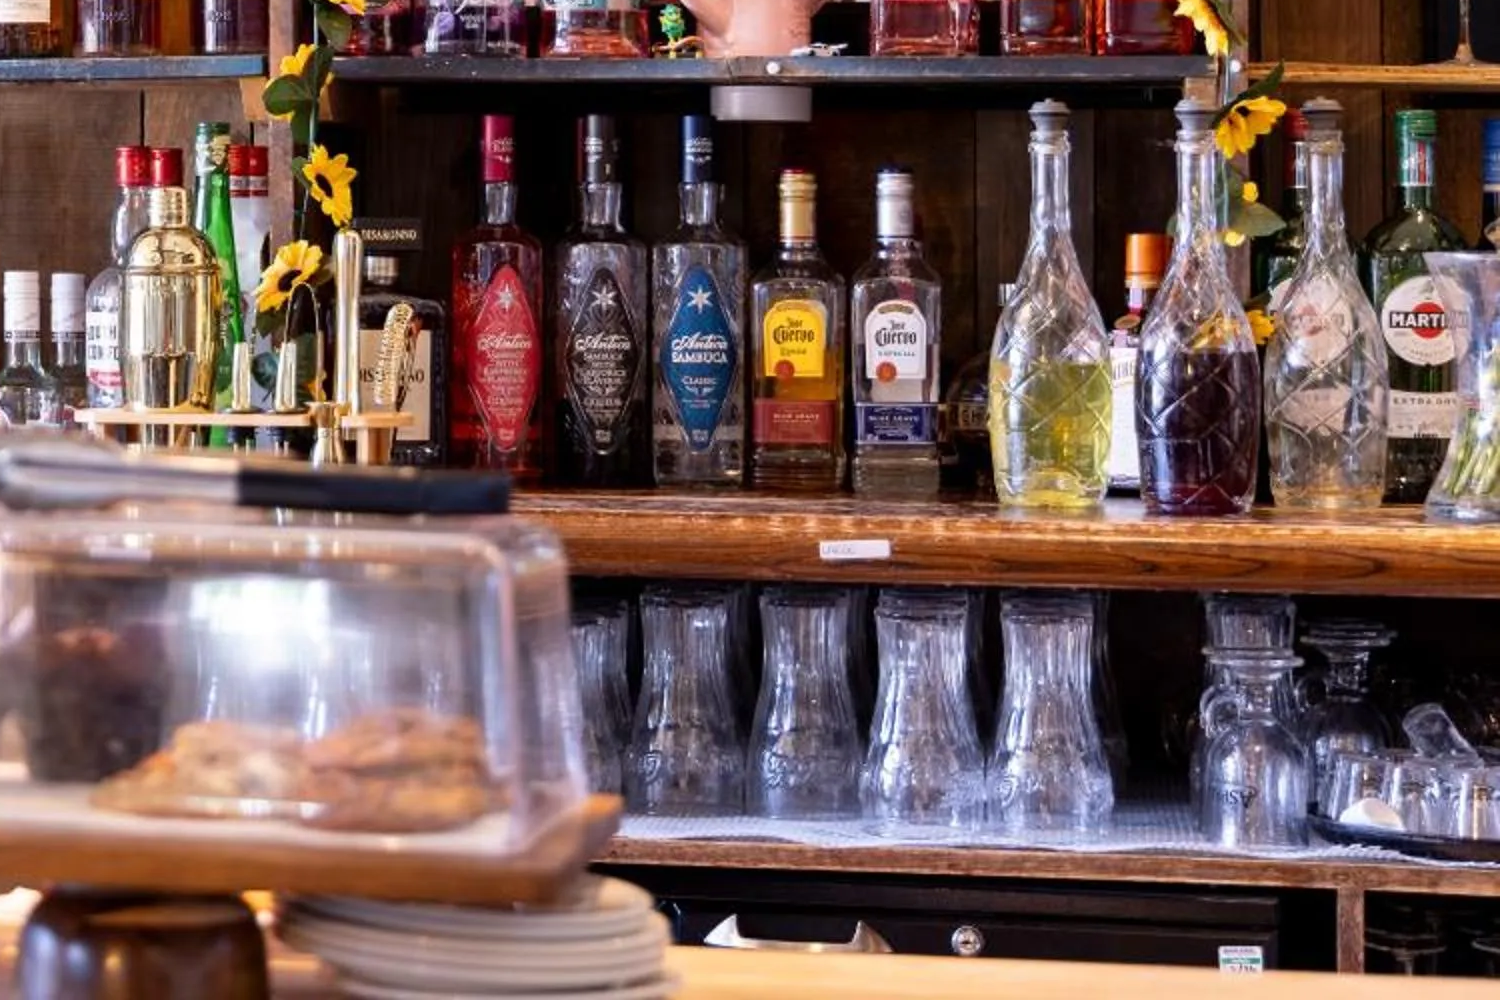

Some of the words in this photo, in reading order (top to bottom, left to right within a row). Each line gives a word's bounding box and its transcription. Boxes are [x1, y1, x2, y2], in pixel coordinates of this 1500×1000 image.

[773, 325, 816, 345] Cuervo
[874, 327, 917, 347] Cuervo
[671, 351, 728, 363] SAMBUCA
